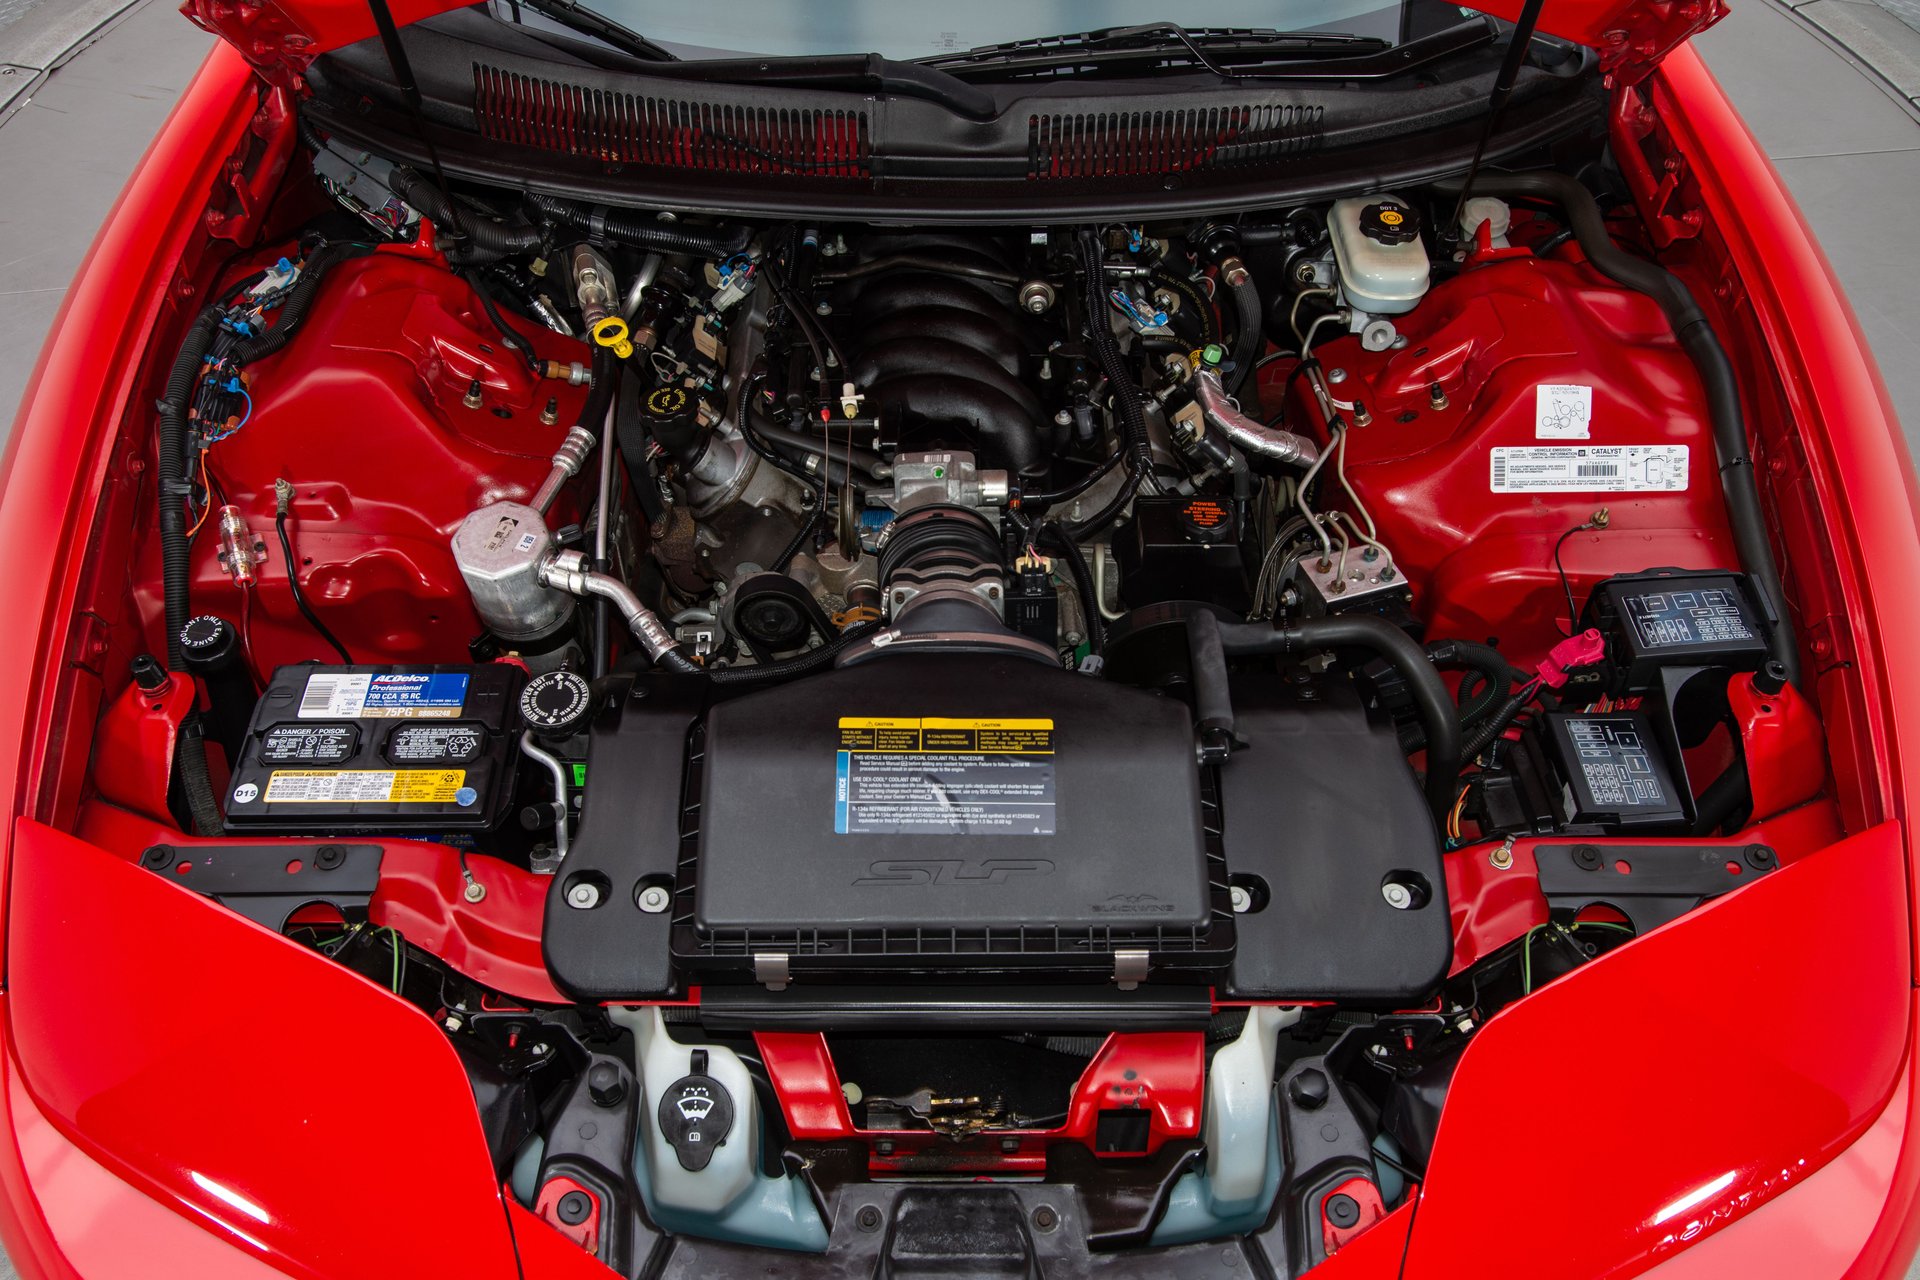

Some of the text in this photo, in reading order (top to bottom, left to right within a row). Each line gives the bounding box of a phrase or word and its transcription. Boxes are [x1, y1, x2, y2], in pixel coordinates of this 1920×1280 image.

[180, 617, 200, 646] COOLANT
[203, 615, 223, 626] ONLY
[522, 676, 546, 720] NEVER OPEN HOT
[384, 708, 413, 716] 75PG
[851, 859, 1056, 886] SLP
[1090, 904, 1175, 913] BLACKWING
